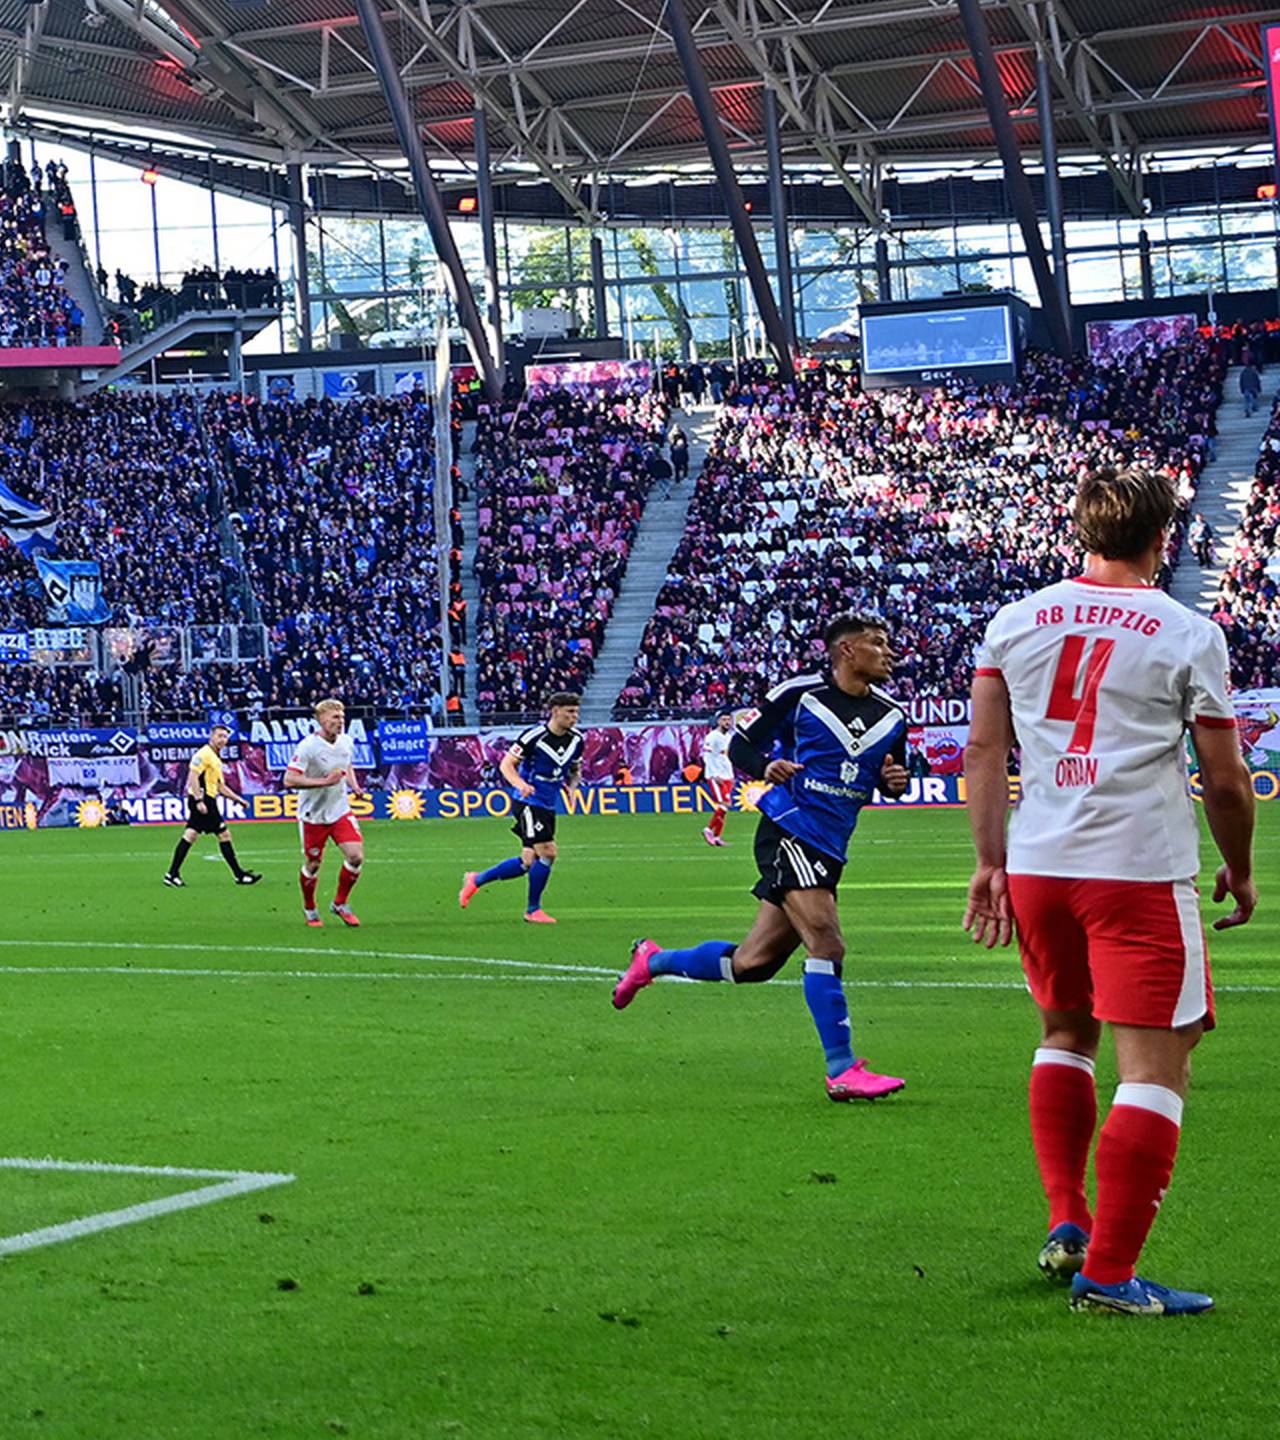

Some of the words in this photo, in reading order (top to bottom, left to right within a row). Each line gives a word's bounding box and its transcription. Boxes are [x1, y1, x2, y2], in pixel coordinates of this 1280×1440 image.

[1035, 605, 1063, 626] RB
[1074, 605, 1161, 636] LEIPZIG
[1045, 634, 1116, 755] 4
[31, 743, 71, 757] Kick
[253, 794, 374, 817] BES
[438, 784, 718, 817] SPOWETTEN
